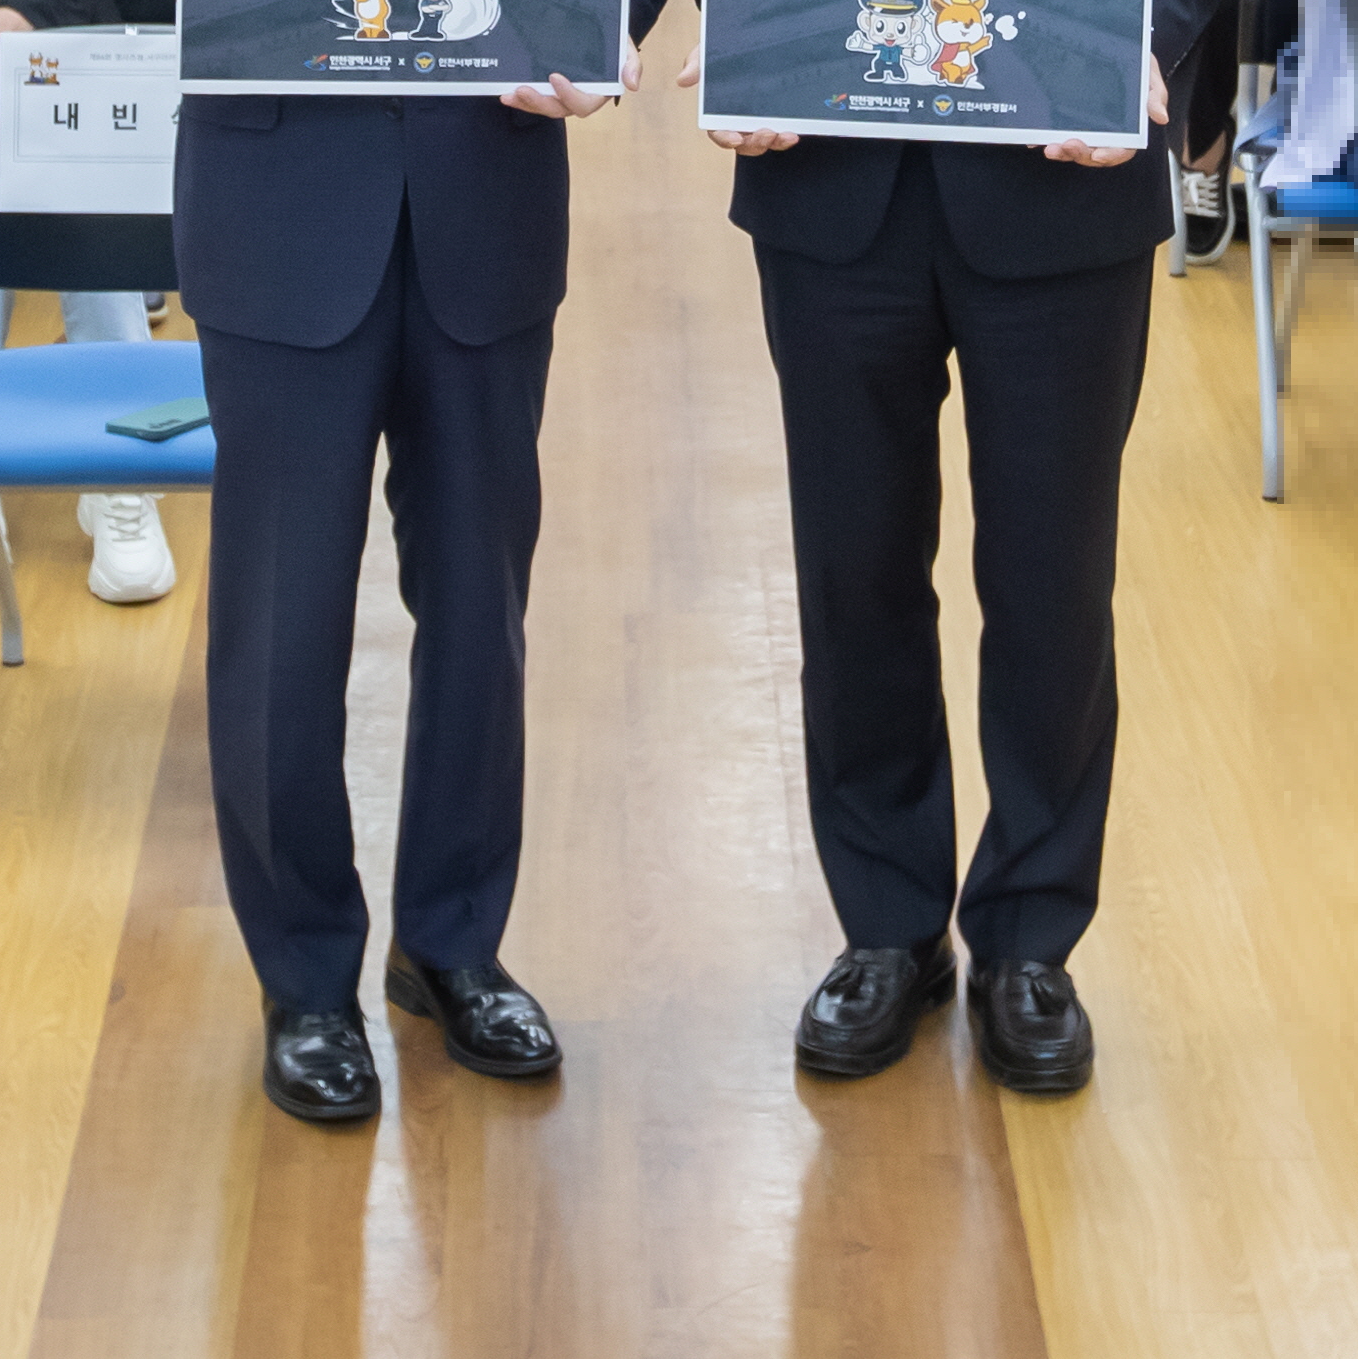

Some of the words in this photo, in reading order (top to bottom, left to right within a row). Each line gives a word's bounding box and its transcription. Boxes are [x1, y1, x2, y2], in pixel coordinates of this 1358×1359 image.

[329, 55, 373, 66] 인천광역시
[374, 55, 392, 66] 서구
[438, 57, 498, 68] 인천서부경찰서
[849, 95, 892, 107] 인천광역시
[893, 97, 911, 108] 서구
[957, 101, 1017, 113] 인천서부경찰서
